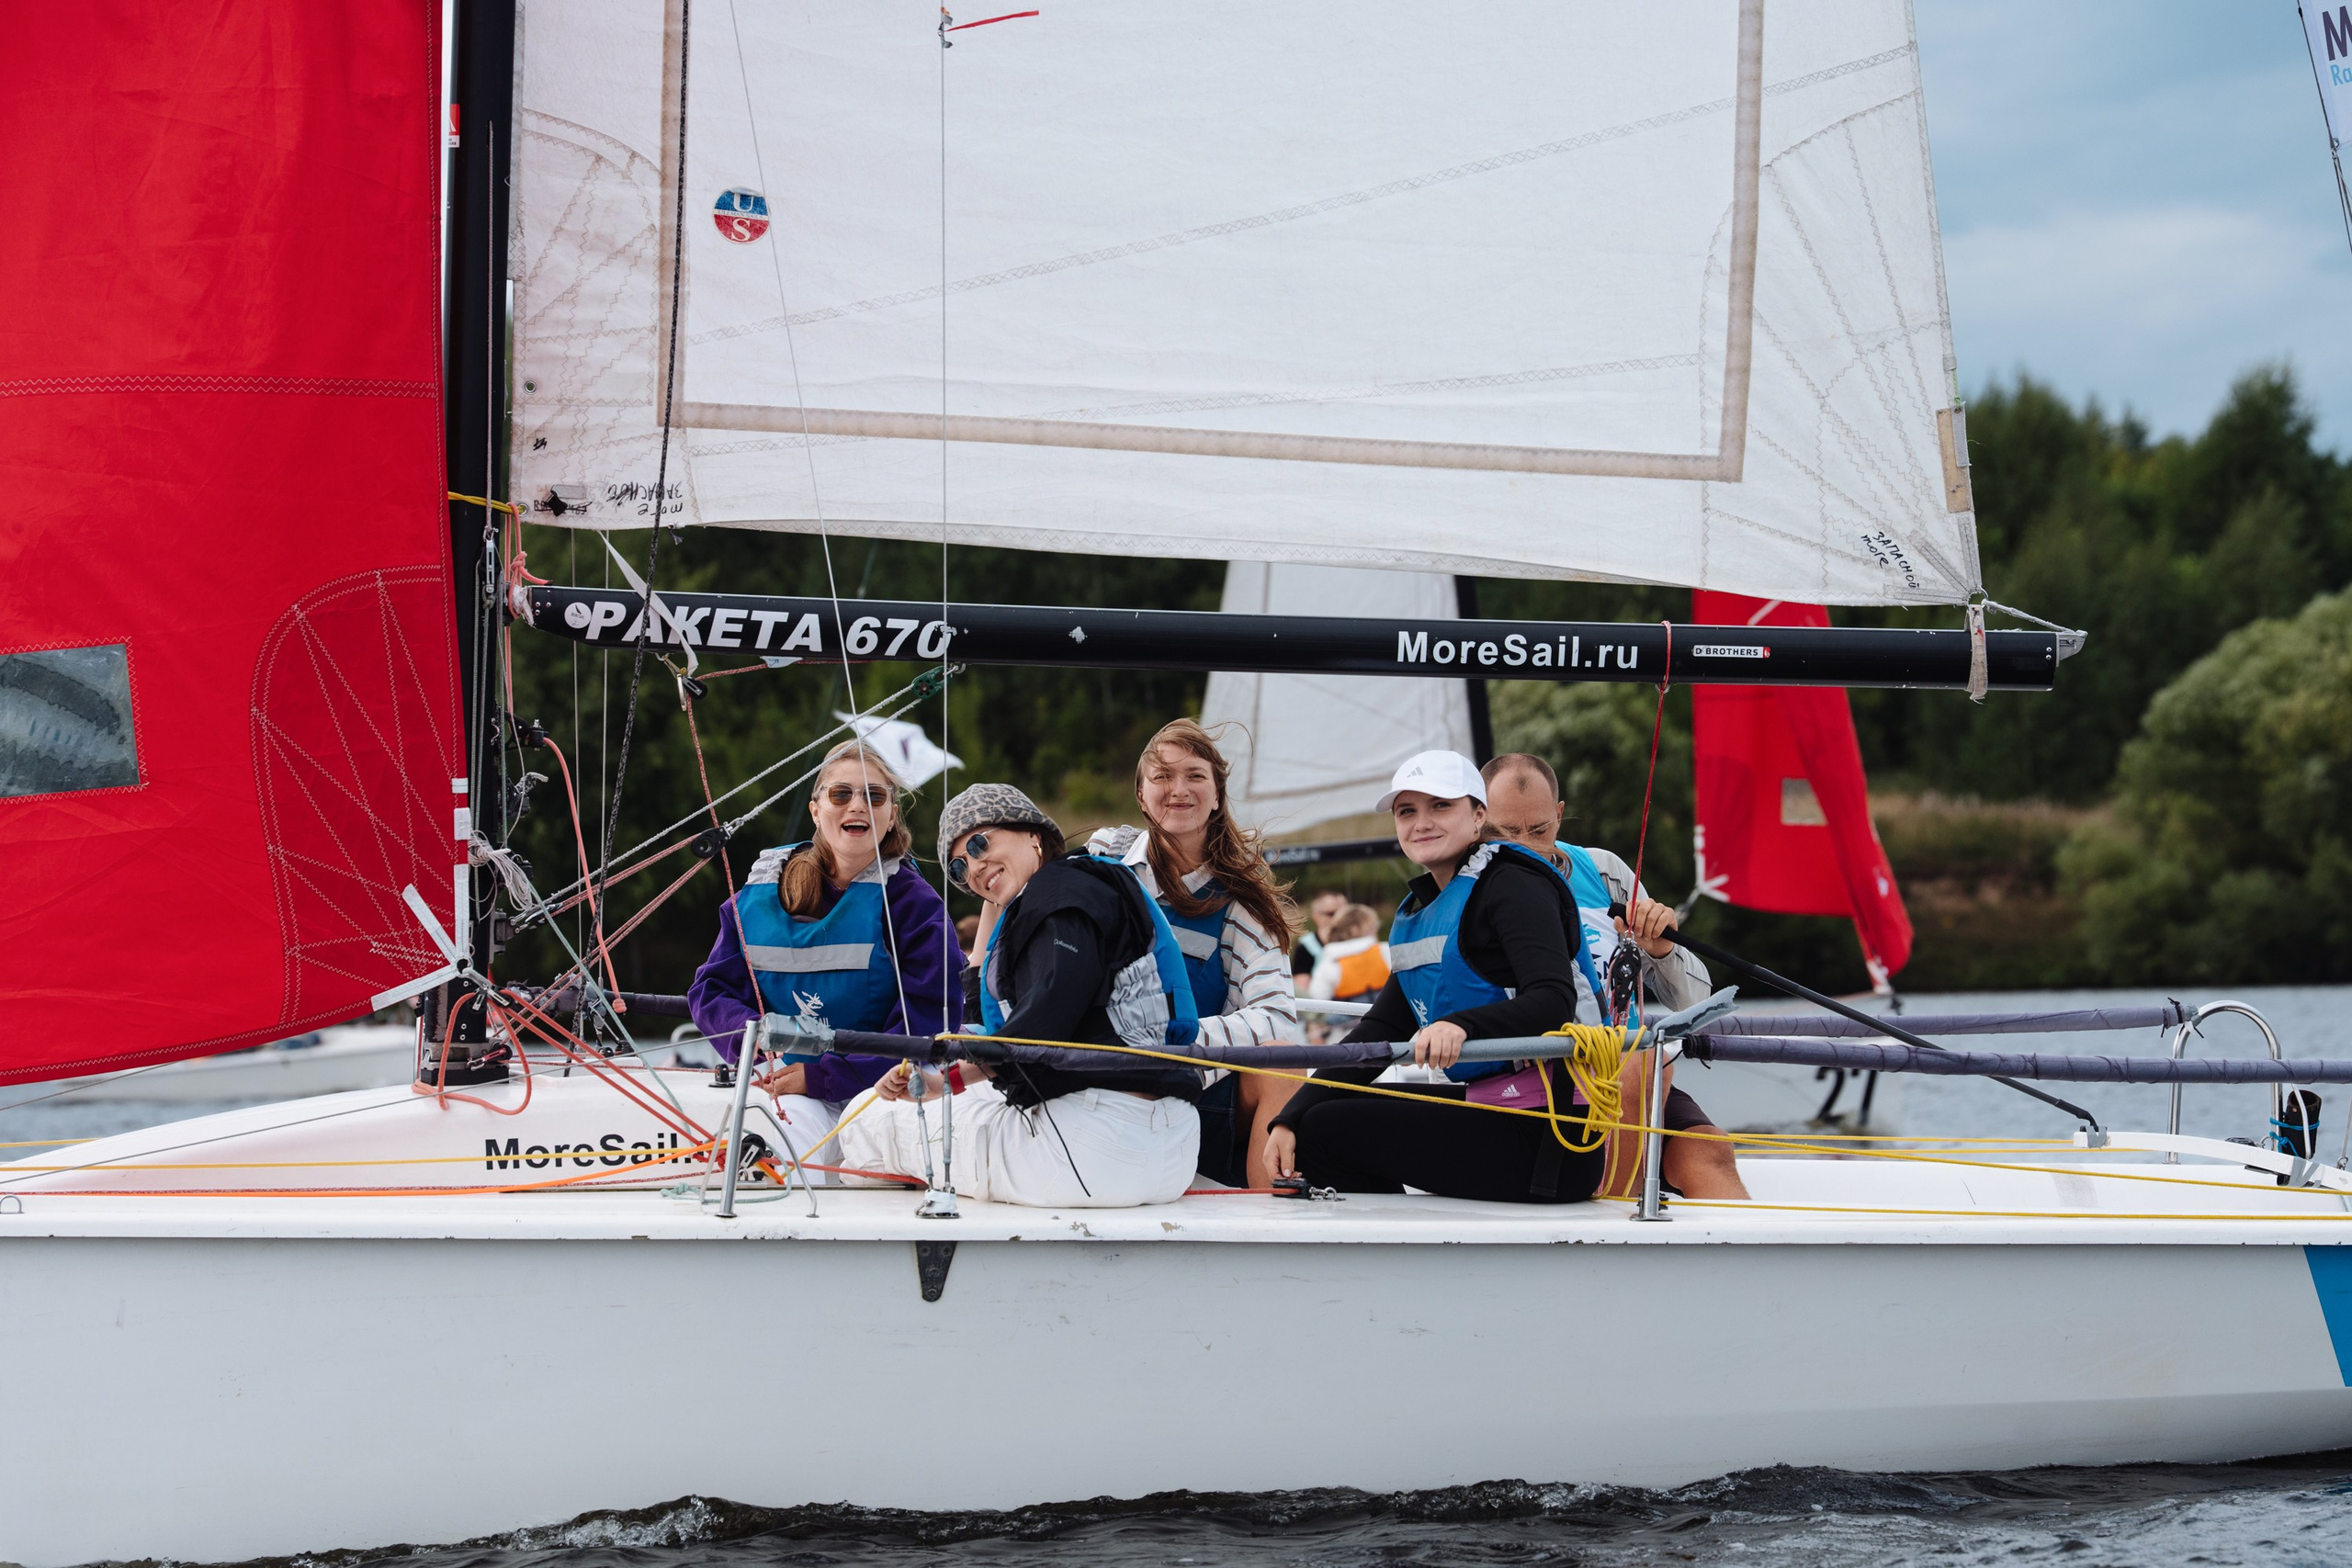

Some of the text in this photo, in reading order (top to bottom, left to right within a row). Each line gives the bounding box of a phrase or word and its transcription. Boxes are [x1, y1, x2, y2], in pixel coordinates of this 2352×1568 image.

[733, 192, 753, 212] U
[731, 218, 751, 242] S
[845, 615, 953, 659] 670
[1396, 630, 1639, 670] MoreSail.ru
[1705, 647, 1758, 656] BROTHERS
[1054, 938, 1079, 953] Columbia
